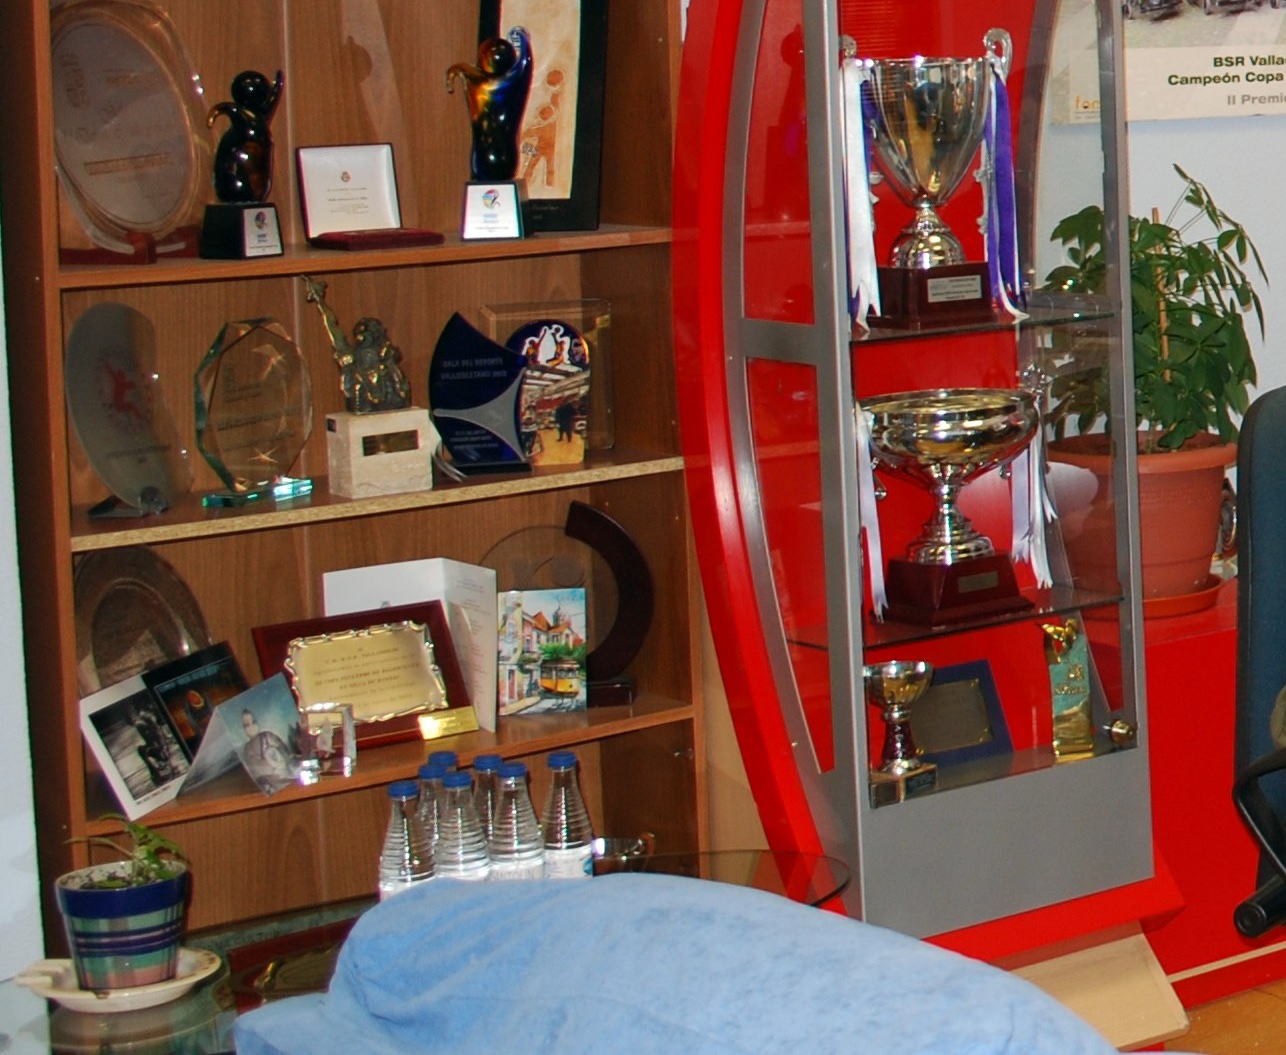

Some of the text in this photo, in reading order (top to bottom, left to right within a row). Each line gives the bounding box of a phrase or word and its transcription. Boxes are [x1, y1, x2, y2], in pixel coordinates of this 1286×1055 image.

[1213, 56, 1245, 68] BSR
[1168, 72, 1240, 86] Campeón
[1245, 72, 1284, 84] Copa
[1227, 95, 1236, 105] II
